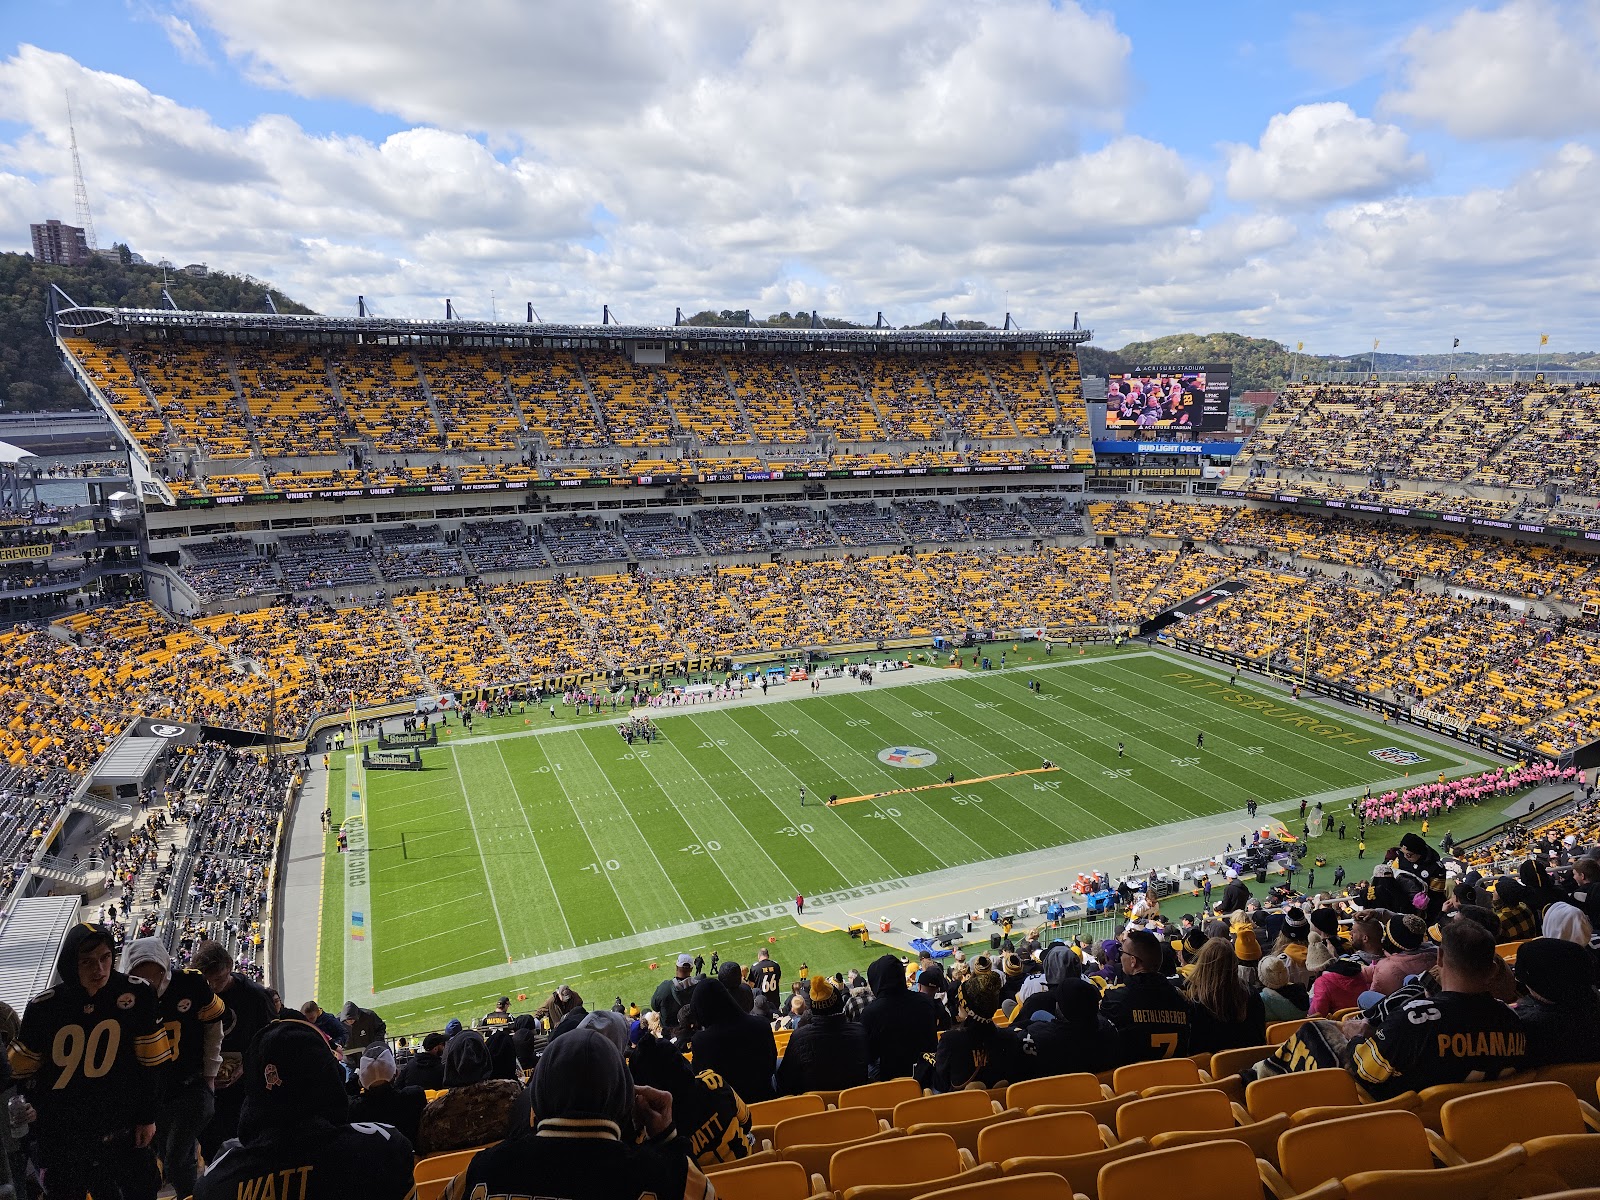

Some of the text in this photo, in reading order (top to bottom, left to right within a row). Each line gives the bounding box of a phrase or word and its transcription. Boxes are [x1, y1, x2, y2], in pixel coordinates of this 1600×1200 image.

[1138, 444, 1155, 452] BUD
[1156, 444, 1179, 452] LIGHT
[1326, 500, 1346, 508] UNIBET
[1388, 508, 1410, 516] UNIBET
[1442, 514, 1466, 523] UNIBET
[1484, 520, 1512, 529] RESPONSIBLY
[1518, 524, 1545, 533] UNIBET
[1161, 672, 1373, 744] PITTSBURGH
[846, 718, 872, 727] 50
[389, 732, 425, 743] Steelers
[776, 728, 800, 738] 40
[703, 739, 730, 748] 30
[373, 754, 408, 764] Steelers
[624, 750, 650, 760] 20
[538, 763, 564, 774] 10
[1102, 768, 1131, 779] 30
[1033, 780, 1060, 792] 40
[952, 794, 983, 806] 50
[872, 808, 902, 820] 40
[782, 824, 814, 837] 30
[688, 840, 722, 856] 20
[349, 846, 366, 888] CRUCIAL
[589, 859, 620, 874] 10
[700, 880, 911, 931] INTERCEPT CANCER
[762, 974, 777, 994] 66
[1132, 1010, 1187, 1025] ROETHLISBERGER
[1151, 1032, 1178, 1060] 7
[52, 1018, 121, 1090] 90
[237, 1166, 314, 1200] WATT
